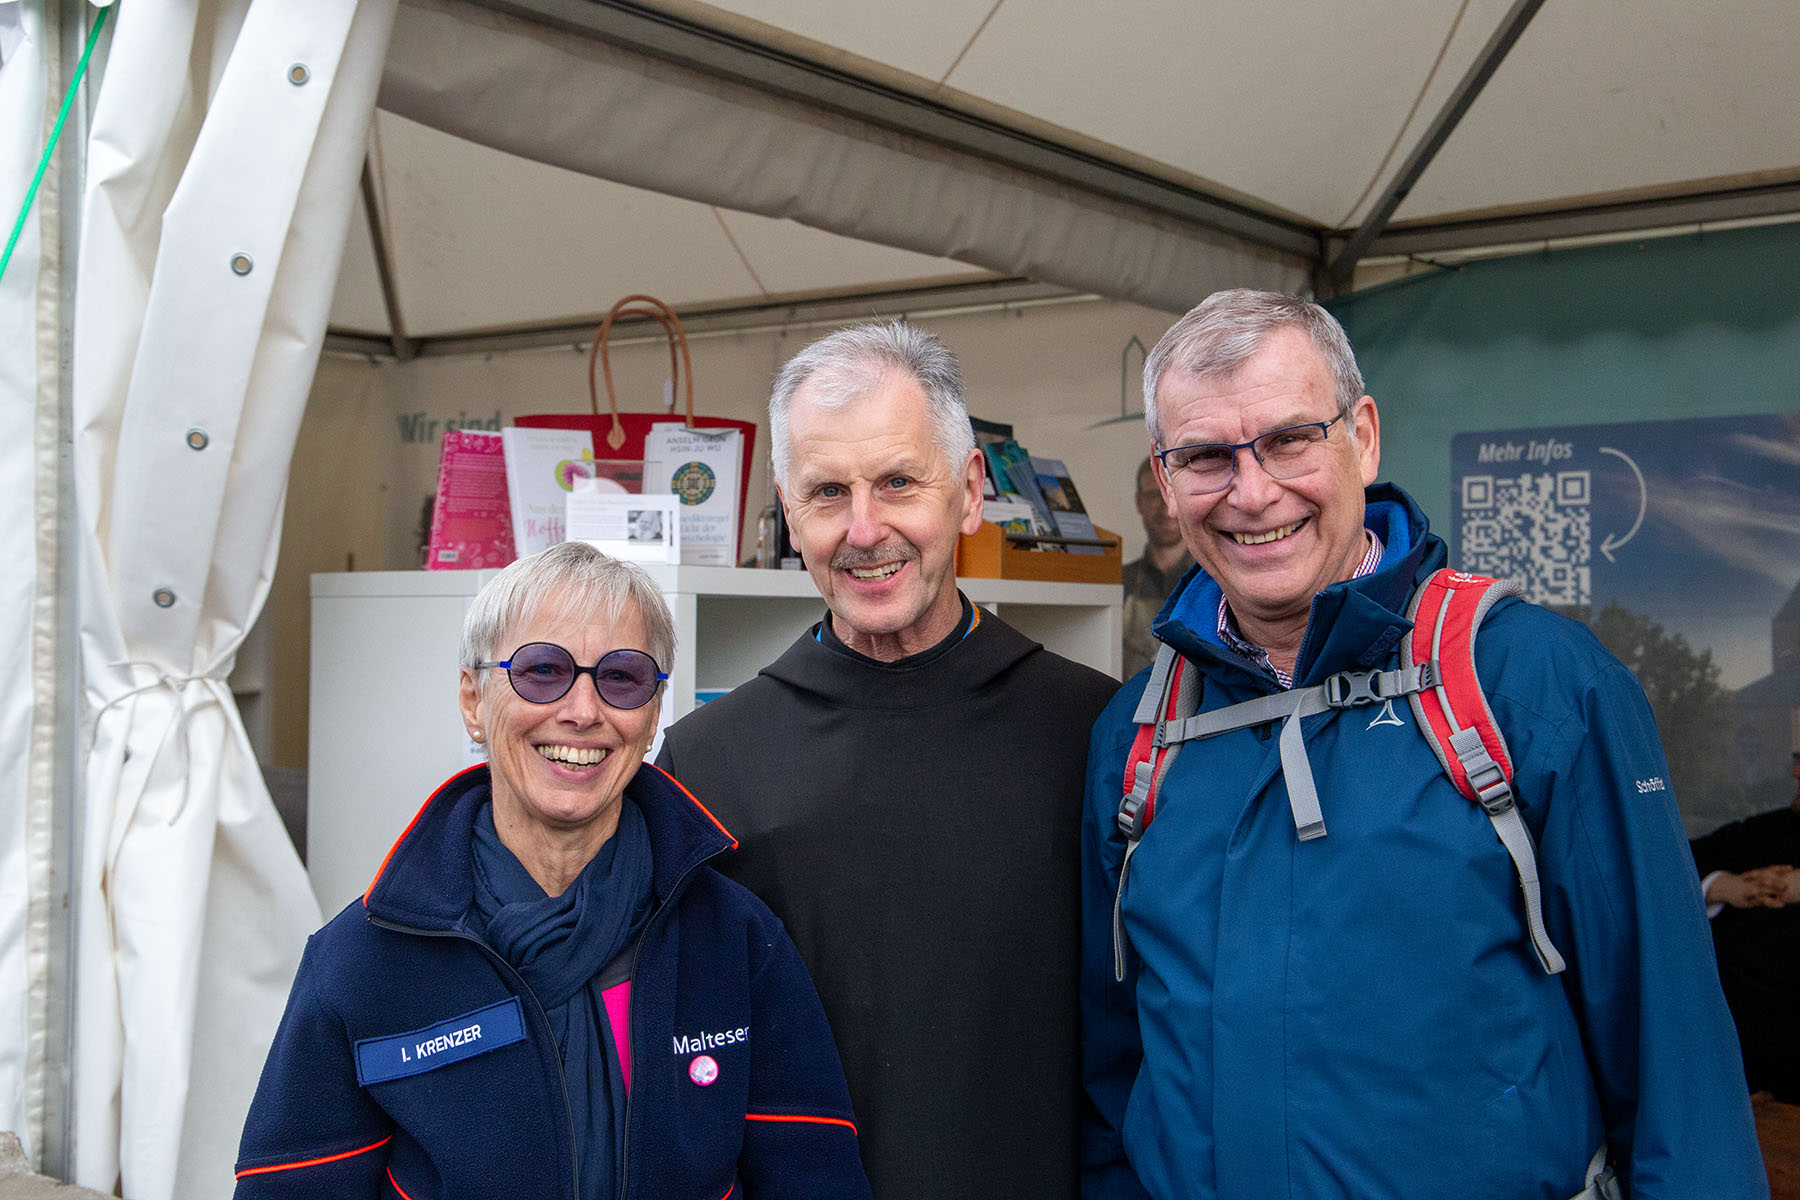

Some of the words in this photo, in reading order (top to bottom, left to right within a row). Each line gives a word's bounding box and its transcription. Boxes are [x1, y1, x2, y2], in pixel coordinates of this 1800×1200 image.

[397, 412, 439, 442] Wir
[445, 409, 502, 432] sind
[665, 436, 702, 445] ANSELM
[1478, 442, 1525, 463] Mehr
[1526, 438, 1573, 465] Infos
[415, 1024, 482, 1060] KRENZER
[672, 1026, 750, 1055] Malteser
